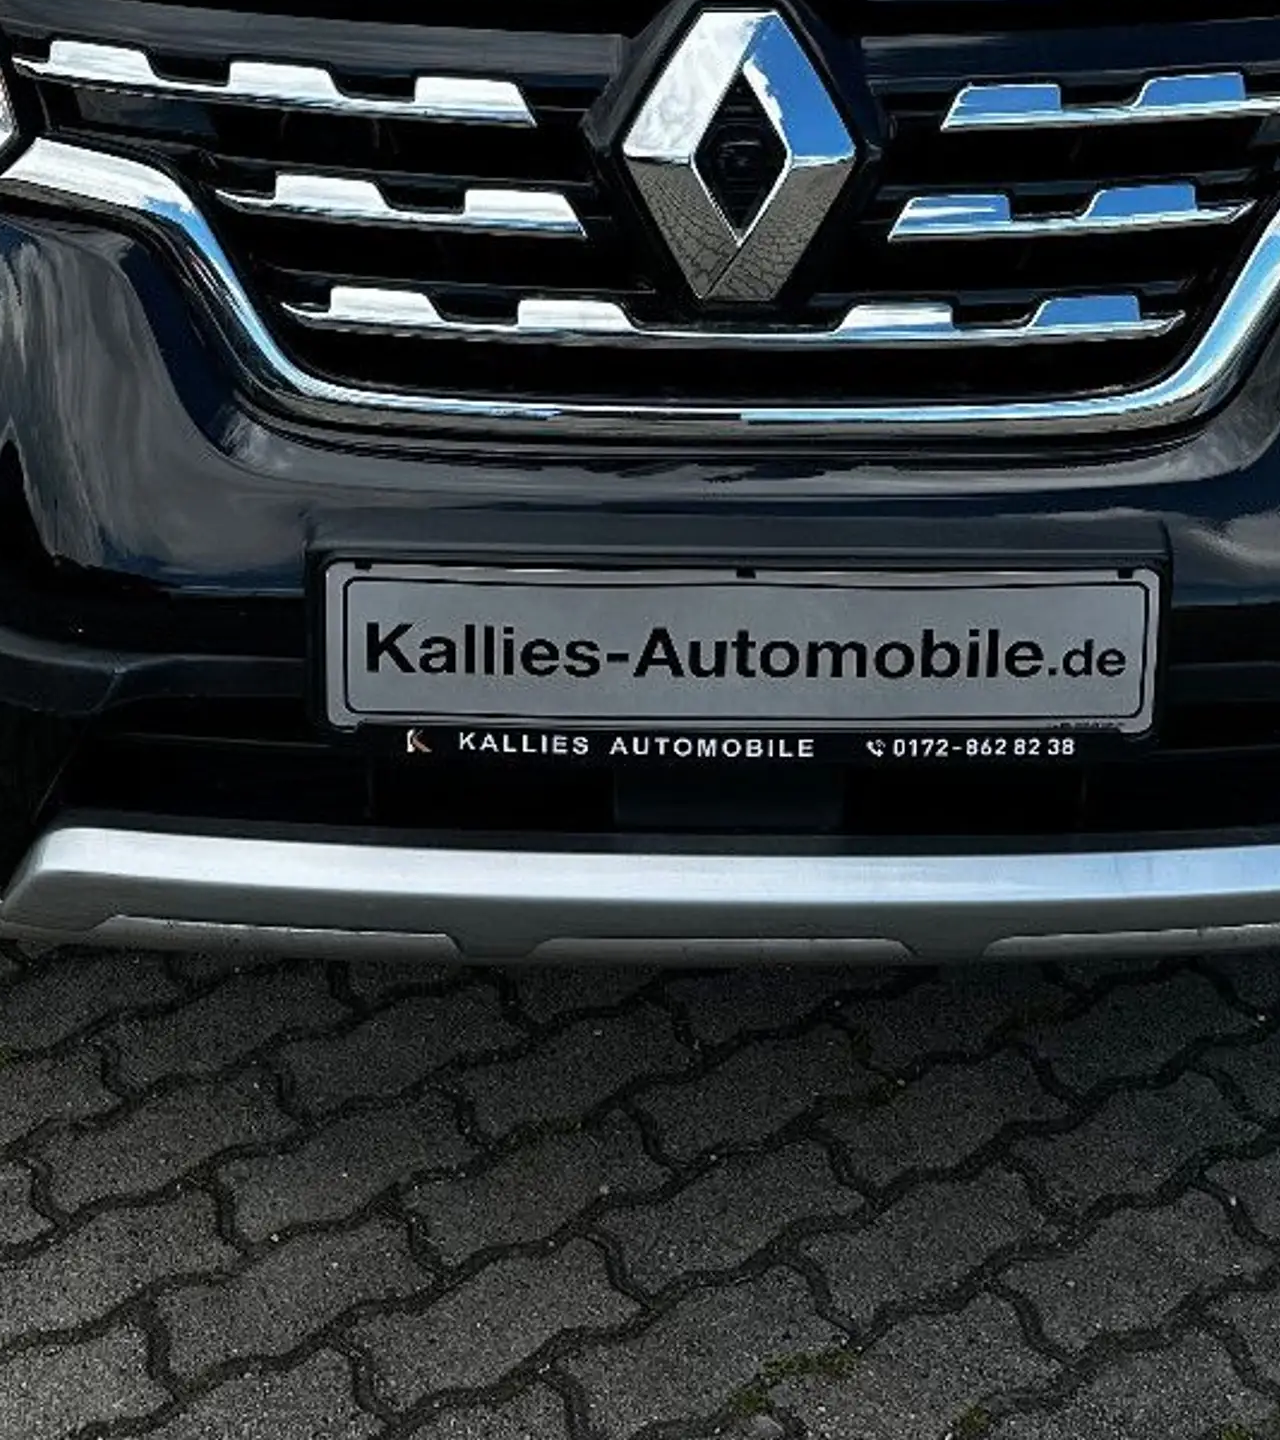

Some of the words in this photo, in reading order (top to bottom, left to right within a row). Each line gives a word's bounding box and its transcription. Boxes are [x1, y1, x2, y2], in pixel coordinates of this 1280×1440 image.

[367, 623, 1125, 679] Kallies-Automobile.de
[460, 732, 588, 754] KALLIES
[609, 737, 813, 757] AUTOMOBILE
[894, 738, 1006, 757] 0172-862
[1014, 738, 1041, 755] 82
[1048, 738, 1074, 755] 38
